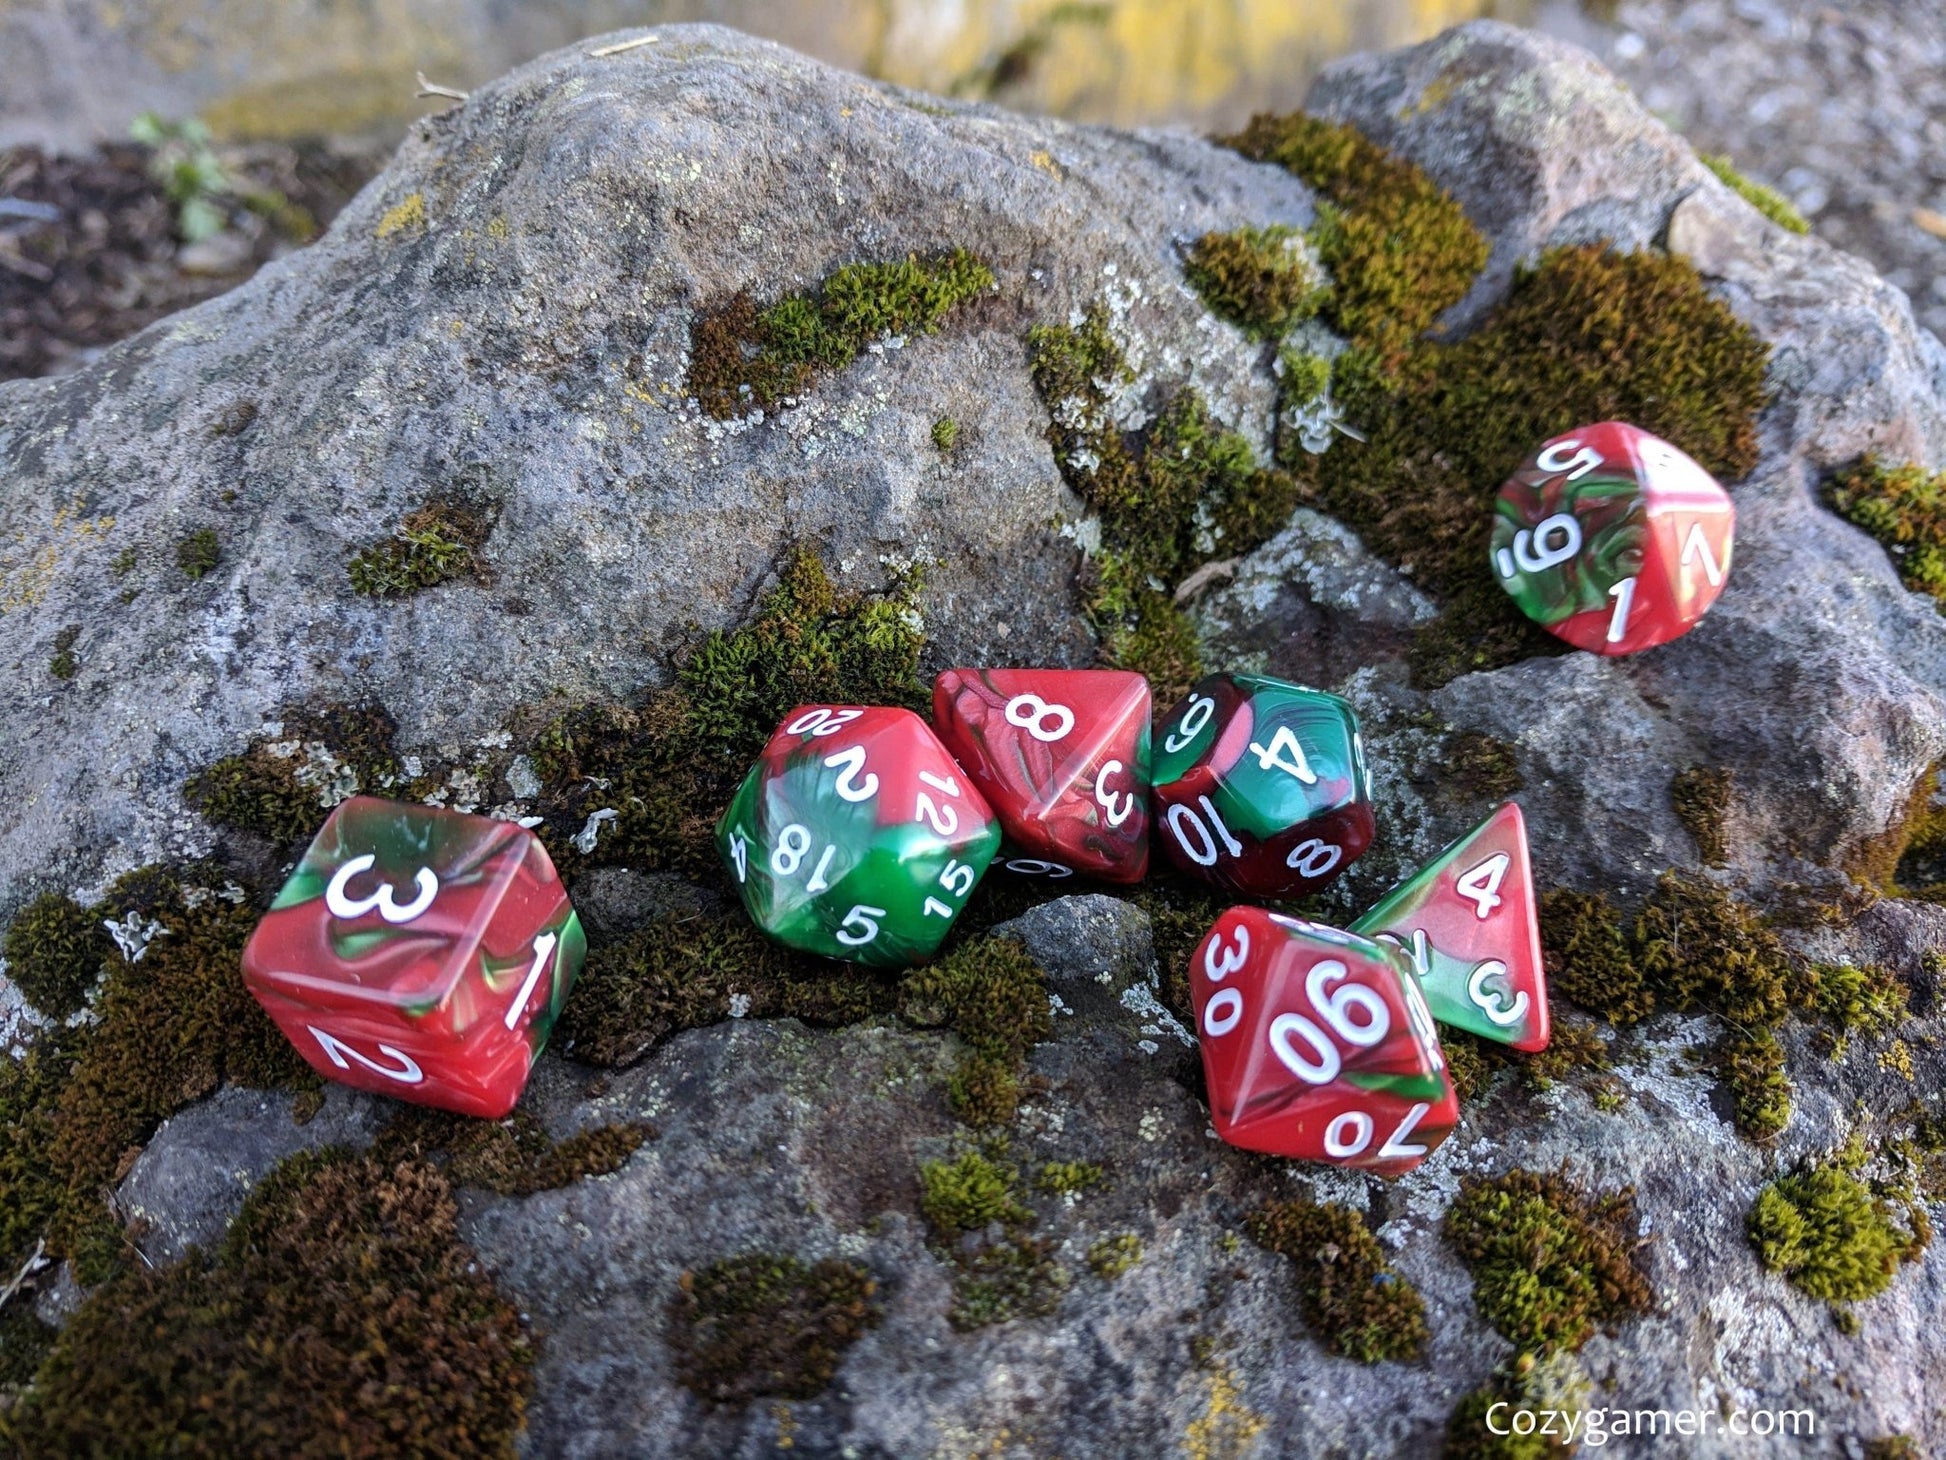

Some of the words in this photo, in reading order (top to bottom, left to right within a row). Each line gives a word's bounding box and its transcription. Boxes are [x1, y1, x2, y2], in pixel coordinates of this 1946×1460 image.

[1607, 576, 1637, 643] 1
[787, 708, 864, 737] 20
[1004, 693, 1075, 743] 8
[824, 745, 880, 803] 2
[1249, 725, 1317, 785] 4
[914, 770, 960, 836] 12
[1094, 759, 1134, 827] 3
[770, 823, 837, 893] 18
[1167, 794, 1243, 867] 10
[1286, 837, 1342, 878] 8
[325, 853, 439, 923] 3
[922, 858, 976, 919] 15
[1456, 852, 1510, 919] 4
[835, 904, 887, 946] 5
[504, 931, 557, 1032] 1
[1204, 923, 1250, 1038] 30
[1467, 959, 1530, 1026] 3
[305, 1023, 425, 1084] 2
[1322, 1102, 1431, 1159] 70
